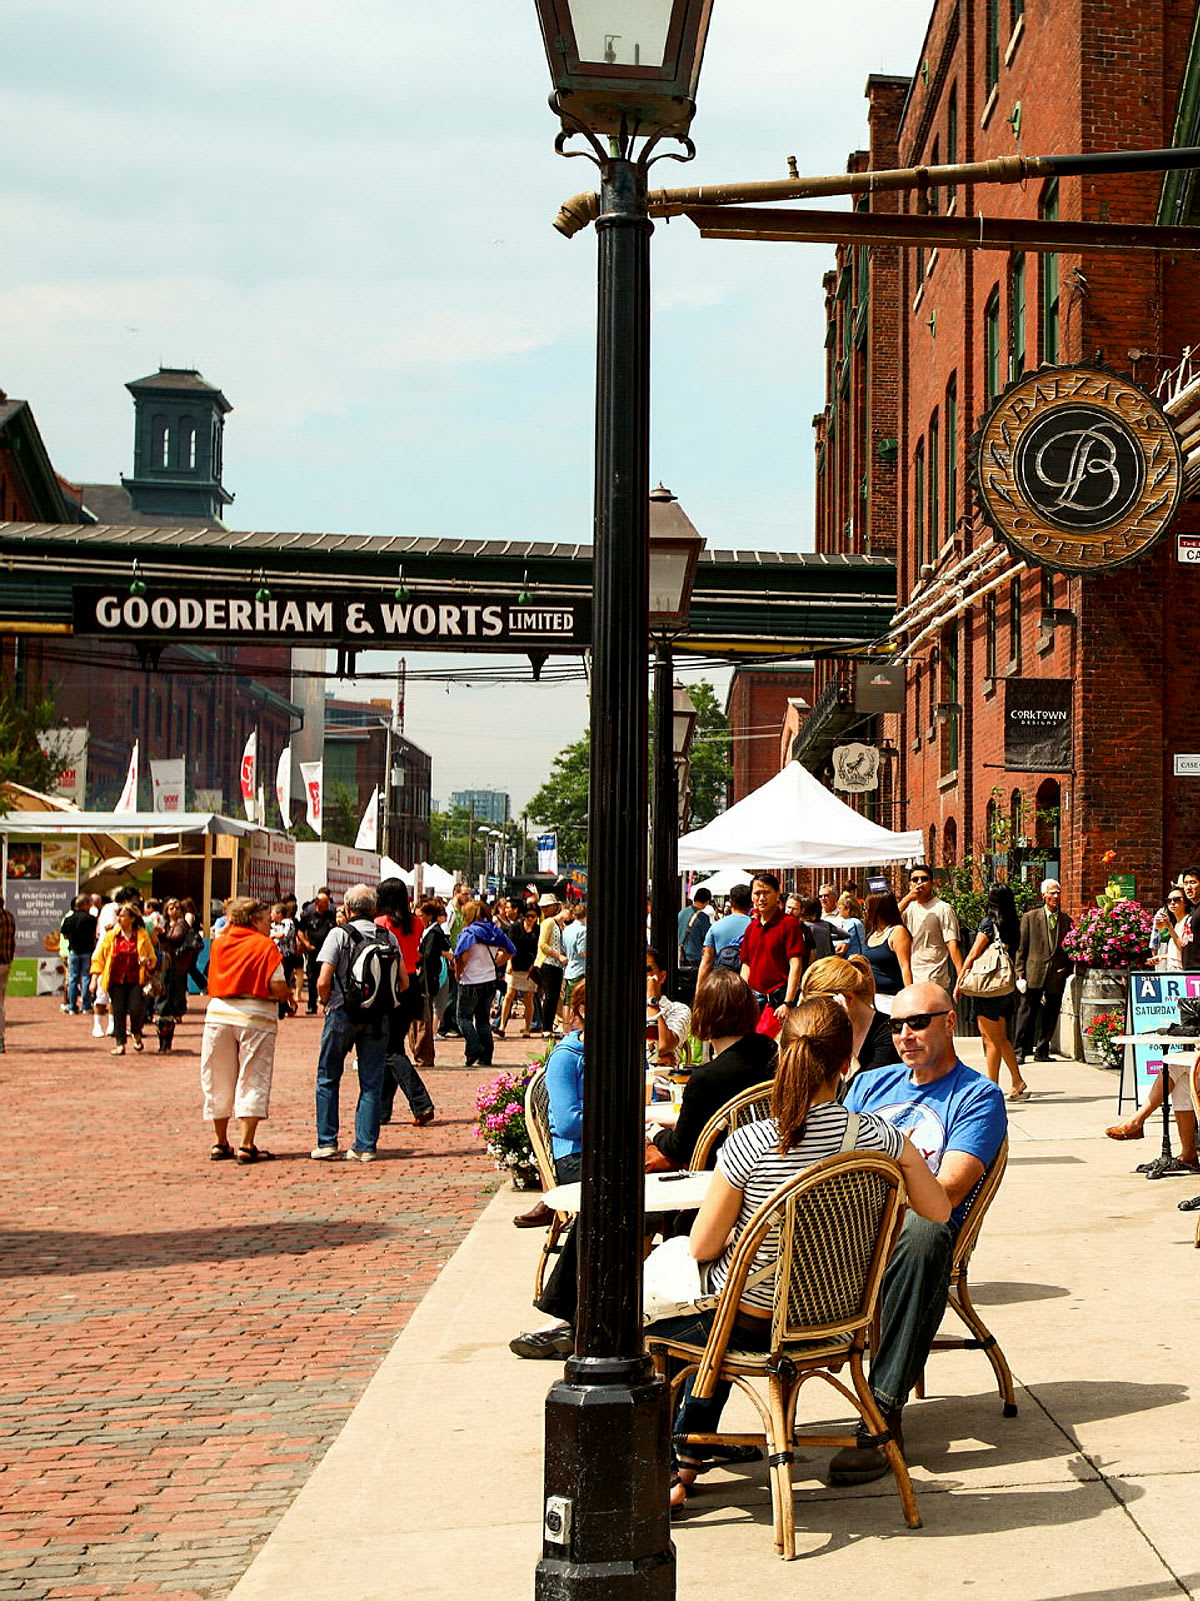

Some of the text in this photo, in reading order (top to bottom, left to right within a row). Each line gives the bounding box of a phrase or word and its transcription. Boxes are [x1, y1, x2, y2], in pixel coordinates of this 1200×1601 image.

[1012, 518, 1136, 560] COFFEE
[95, 596, 574, 637] GOODERHAM & WORTS LIMITED
[1134, 1005, 1177, 1016] SATURDAY
